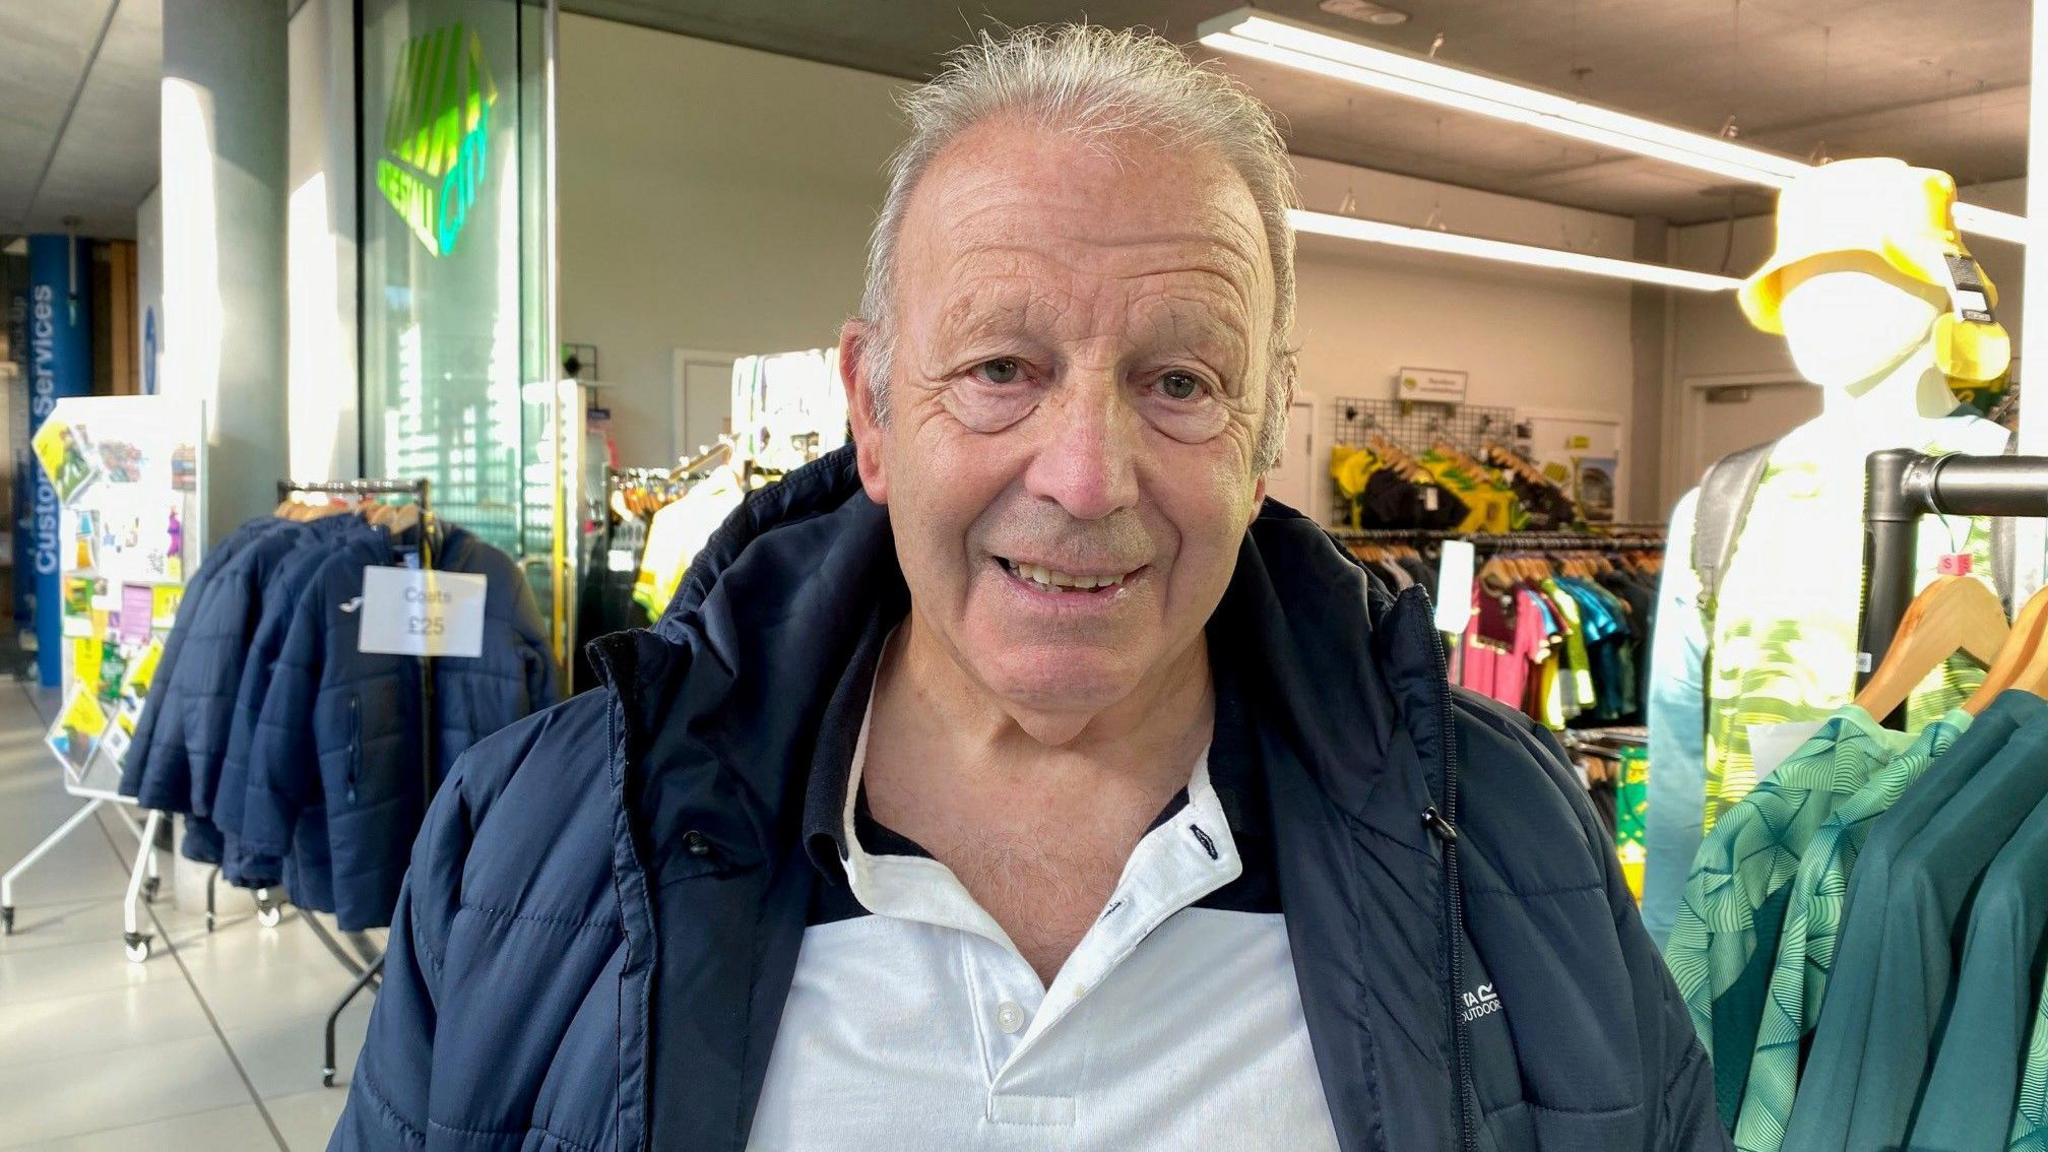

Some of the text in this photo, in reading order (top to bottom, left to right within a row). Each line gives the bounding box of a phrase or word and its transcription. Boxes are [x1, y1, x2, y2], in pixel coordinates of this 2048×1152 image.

[34, 284, 54, 417] Services
[1944, 558, 1952, 569] S
[405, 586, 452, 604] Coats
[409, 616, 445, 636] £25
